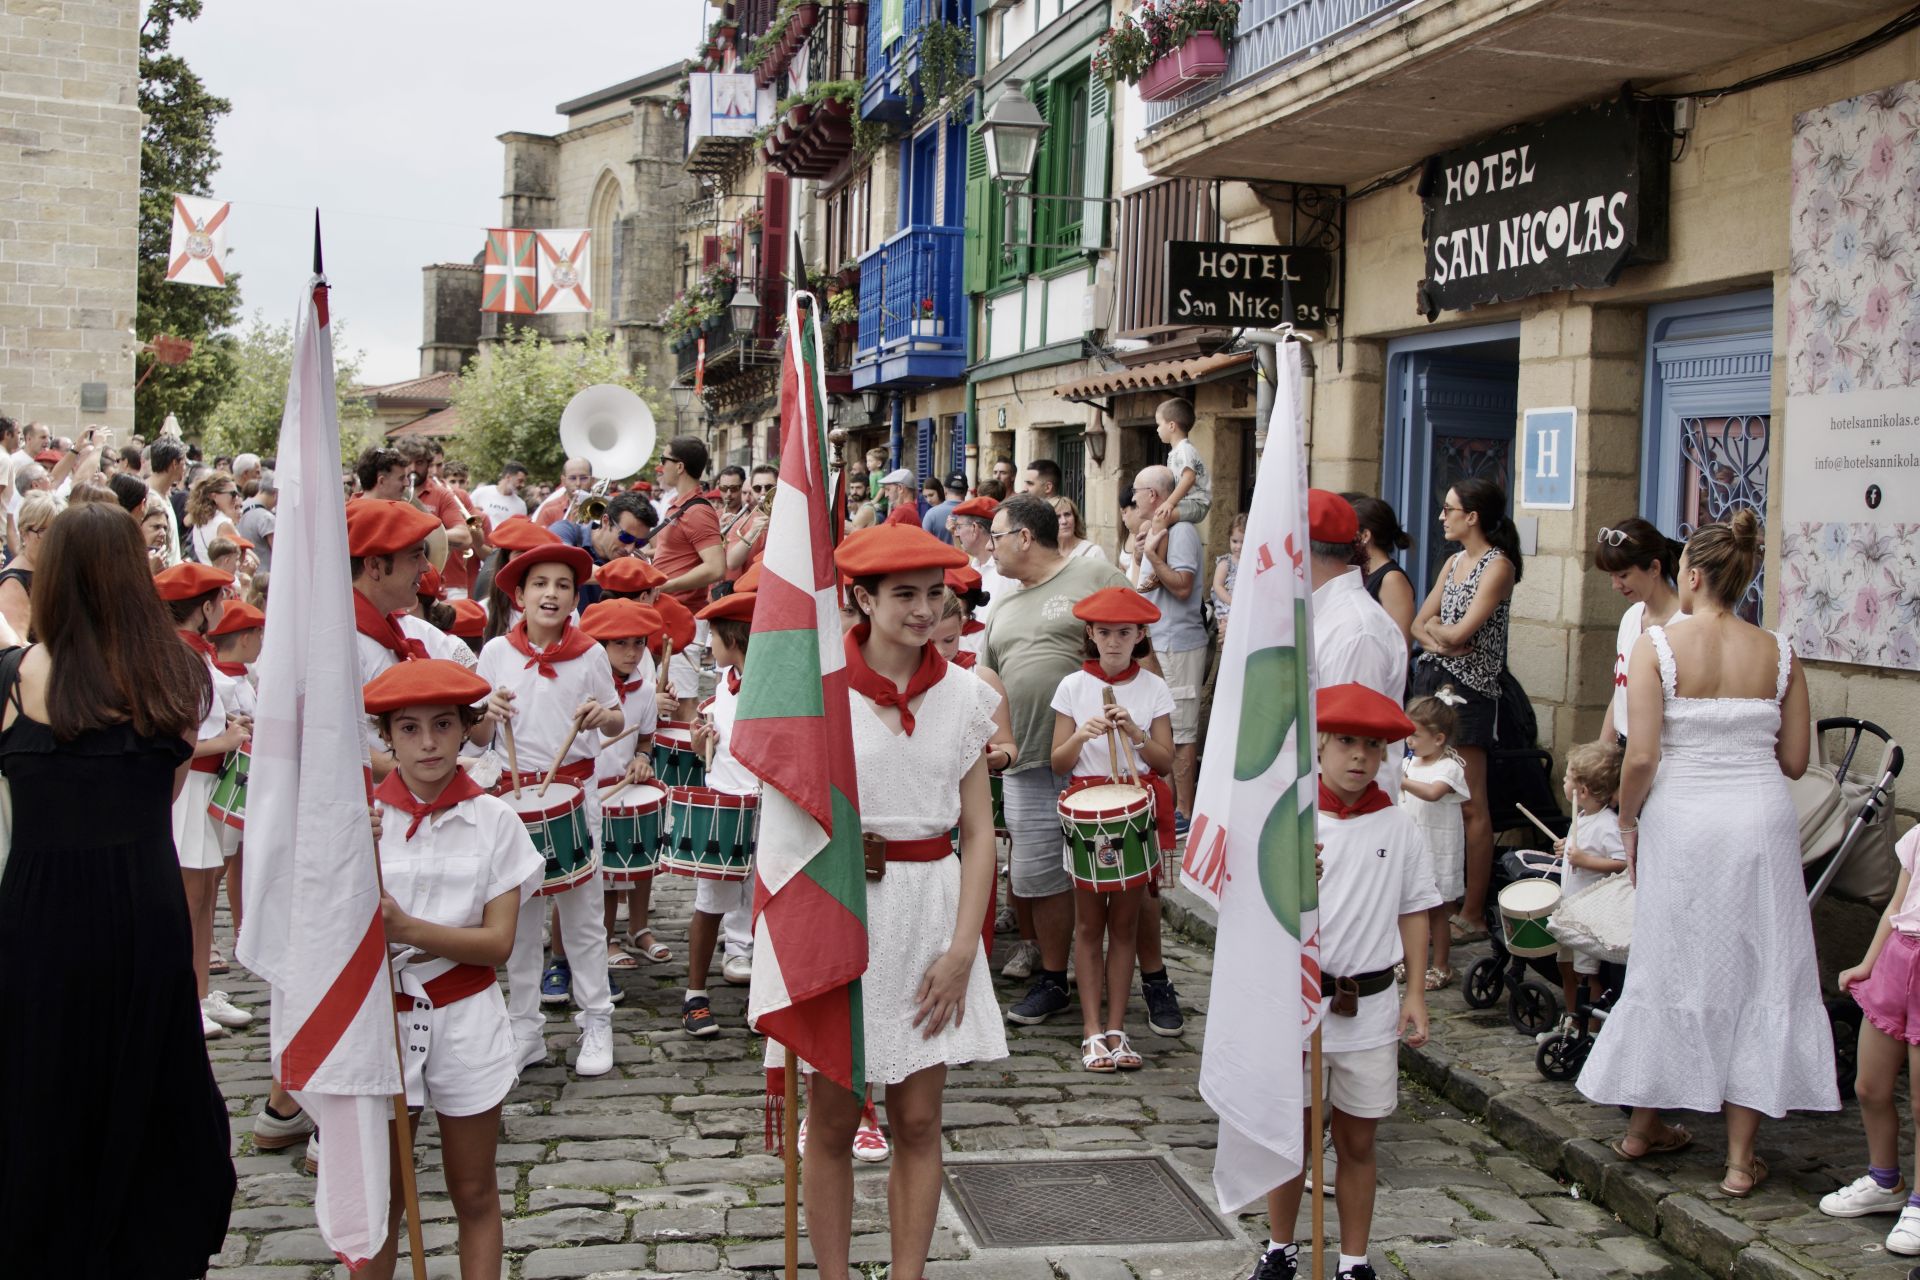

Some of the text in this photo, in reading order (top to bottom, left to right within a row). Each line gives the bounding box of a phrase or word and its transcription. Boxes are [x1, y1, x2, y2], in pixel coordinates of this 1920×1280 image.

[1445, 145, 1536, 205] HOTEL
[1198, 251, 1300, 281] HOTEL
[1433, 223, 1490, 285] SAN
[1177, 288, 1217, 316] San
[1536, 430, 1560, 477] H
